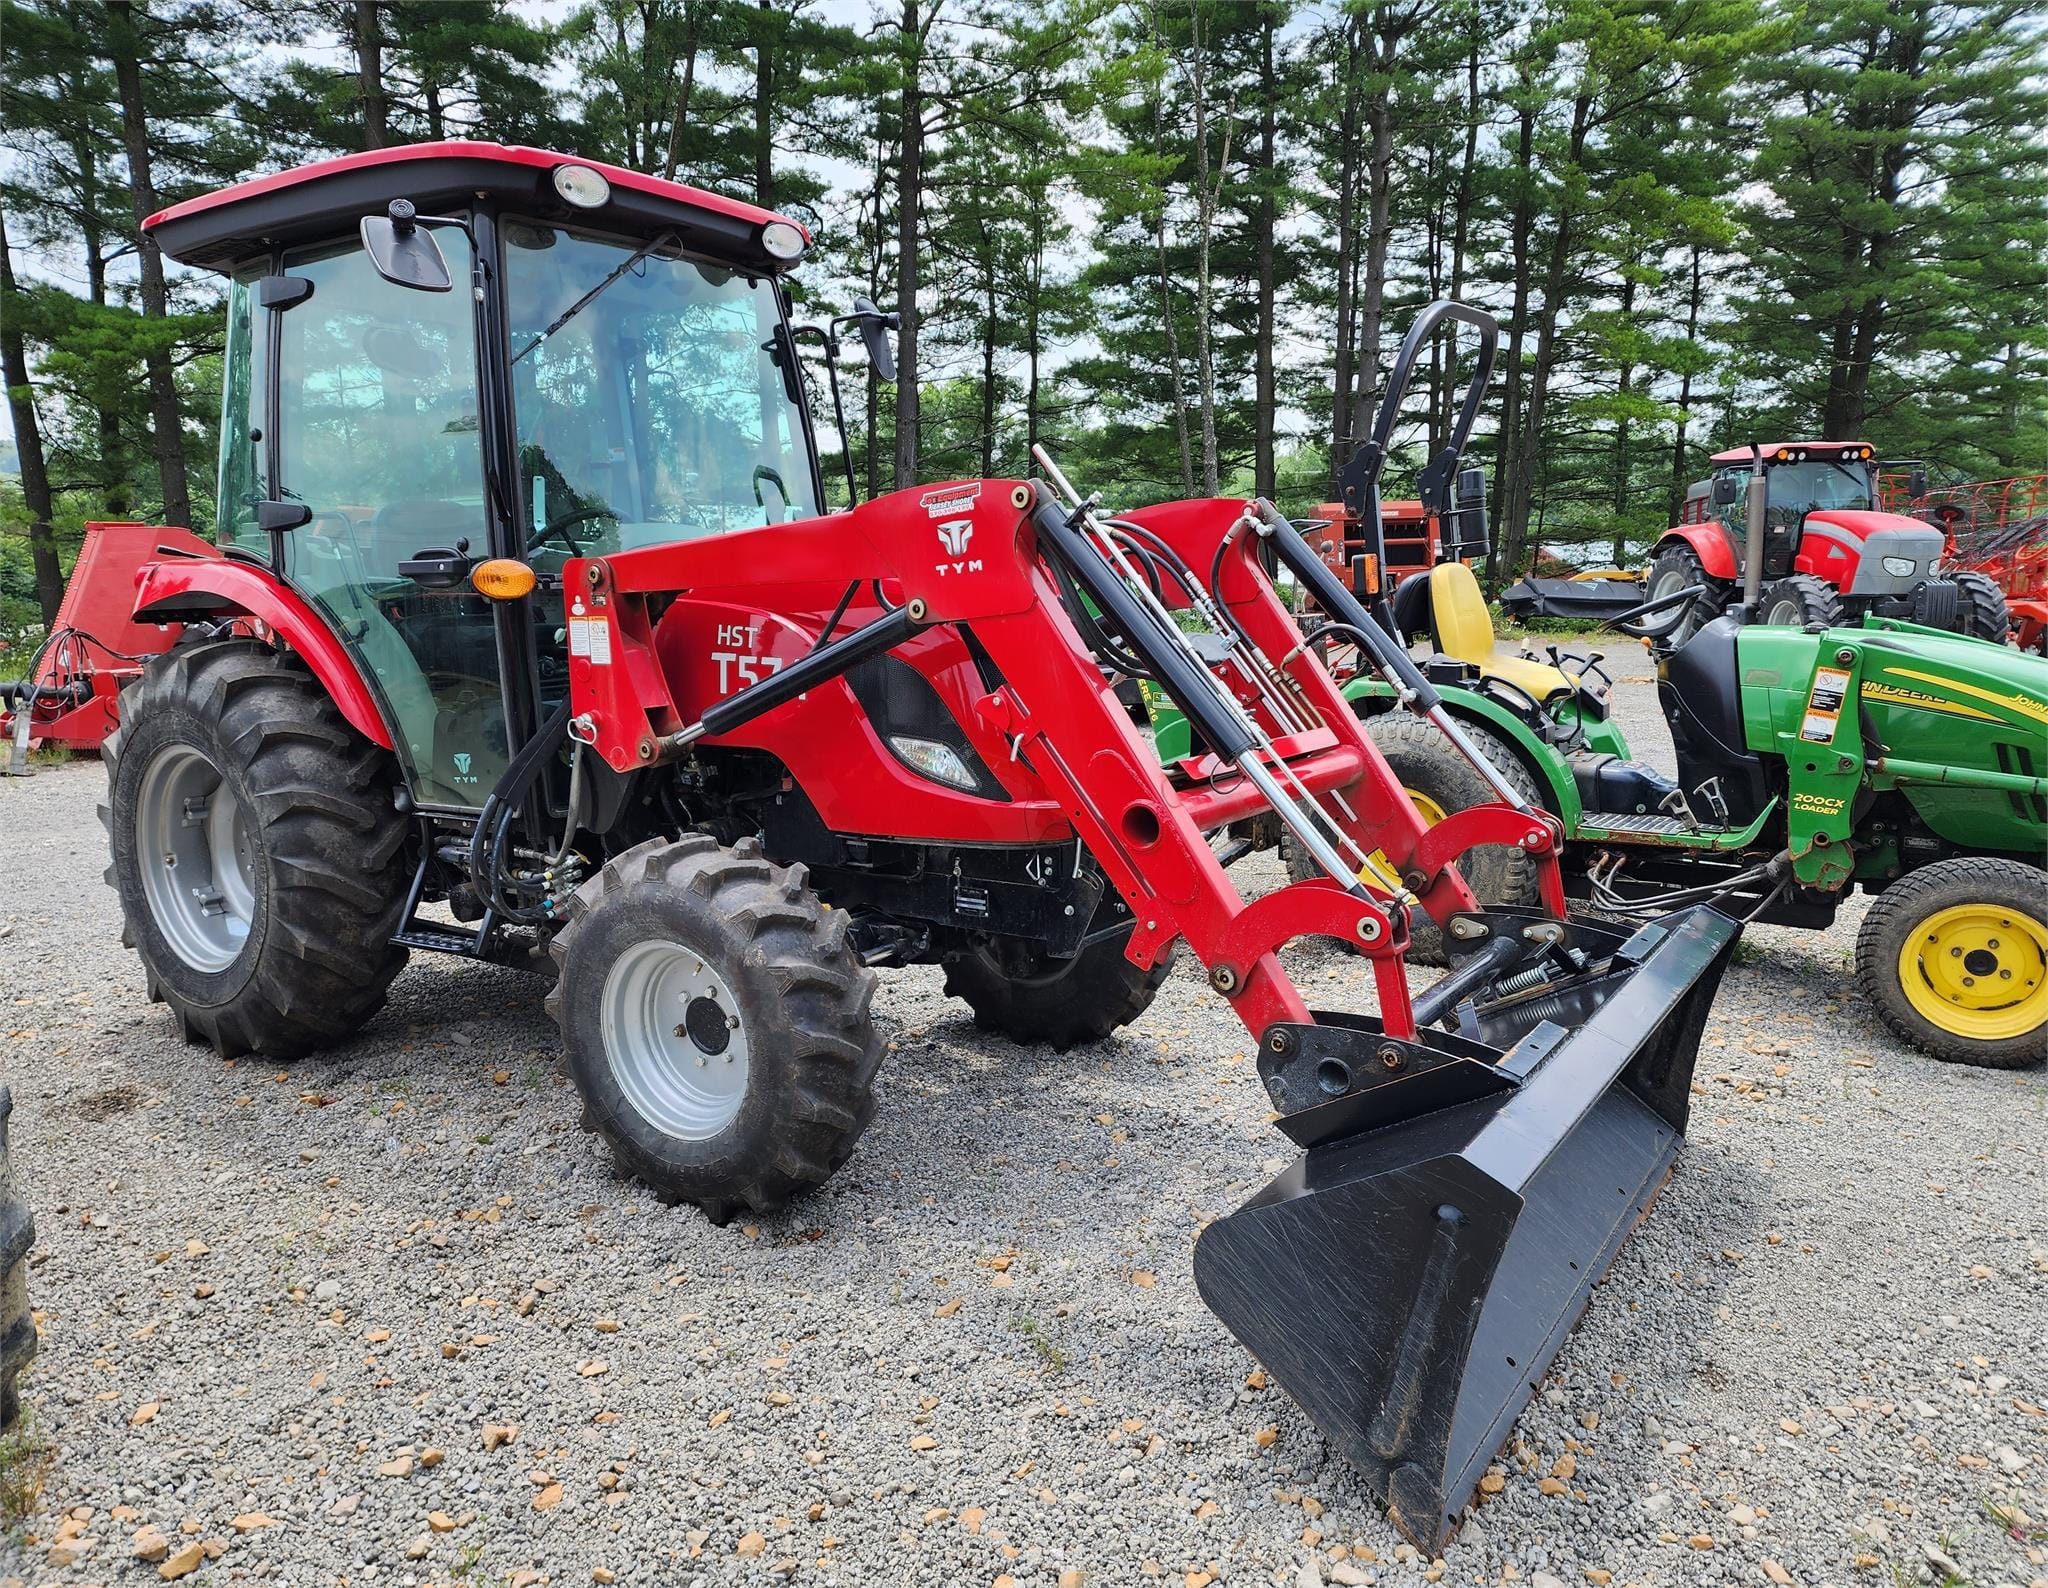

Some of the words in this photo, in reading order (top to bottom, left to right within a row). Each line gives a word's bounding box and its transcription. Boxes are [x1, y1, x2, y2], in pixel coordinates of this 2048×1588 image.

[935, 560, 983, 576] TYM
[717, 624, 758, 648] HST
[711, 652, 806, 700] T57
[1138, 679, 1151, 701] ERE
[2009, 694, 2048, 713] JOHN
[453, 776, 478, 784] TYM
[1793, 793, 1846, 809] 200CX
[1794, 803, 1839, 816] LOADER
